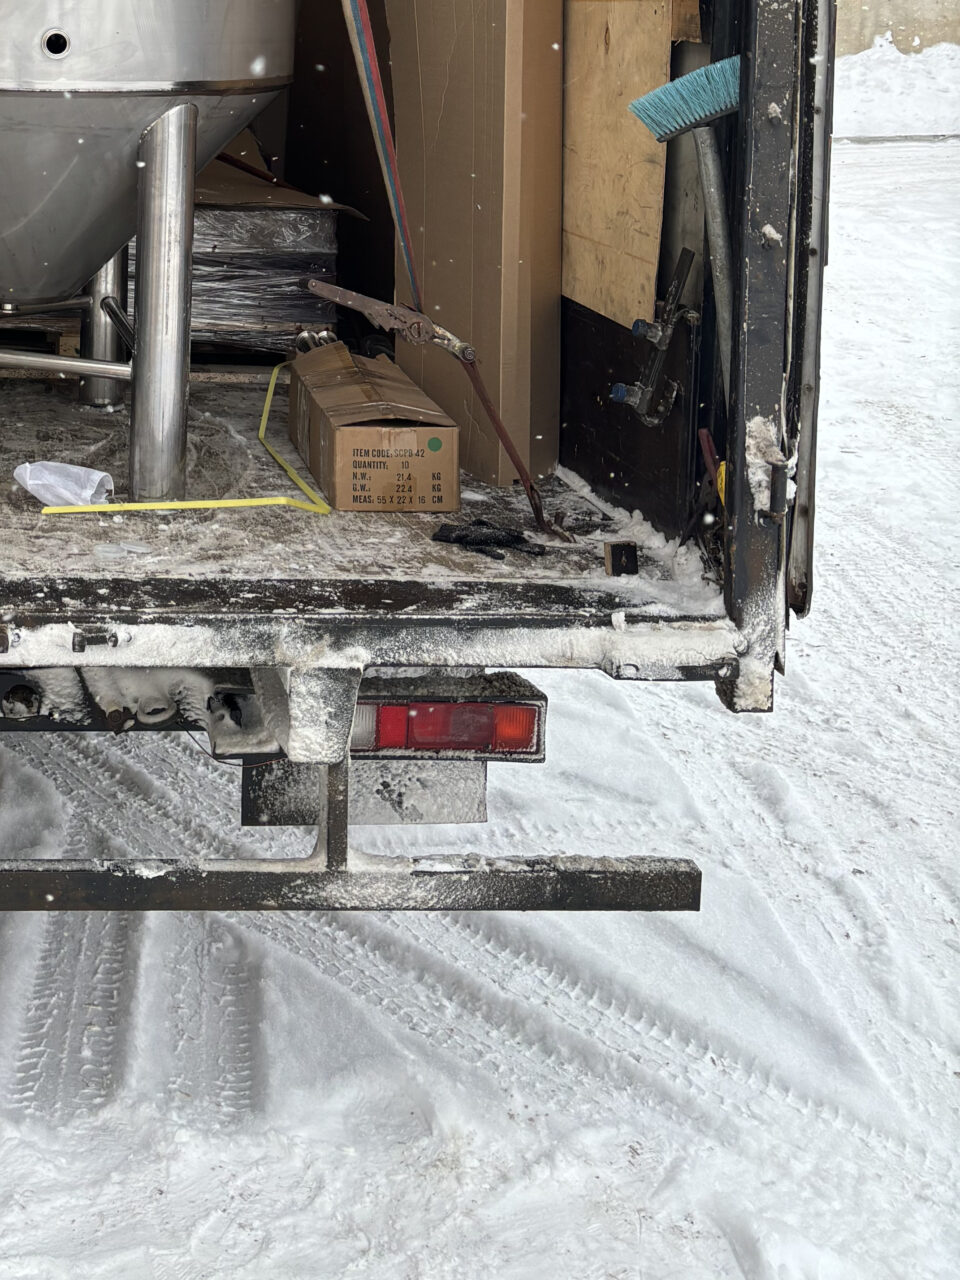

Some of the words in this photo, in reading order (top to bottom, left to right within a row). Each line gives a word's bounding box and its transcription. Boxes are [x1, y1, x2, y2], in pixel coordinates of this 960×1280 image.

[352, 448, 369, 458] ITEM
[372, 449, 392, 458] CODE:
[352, 461, 388, 470] QUANTITY:
[401, 461, 409, 469] 10
[396, 473, 412, 481] 21.4
[432, 472, 441, 480] KG
[396, 484, 412, 493] 22.4
[432, 484, 441, 492] KG
[377, 496, 386, 504] 55
[397, 496, 406, 504] 22
[418, 496, 426, 504] 16
[432, 495, 443, 504] CM
